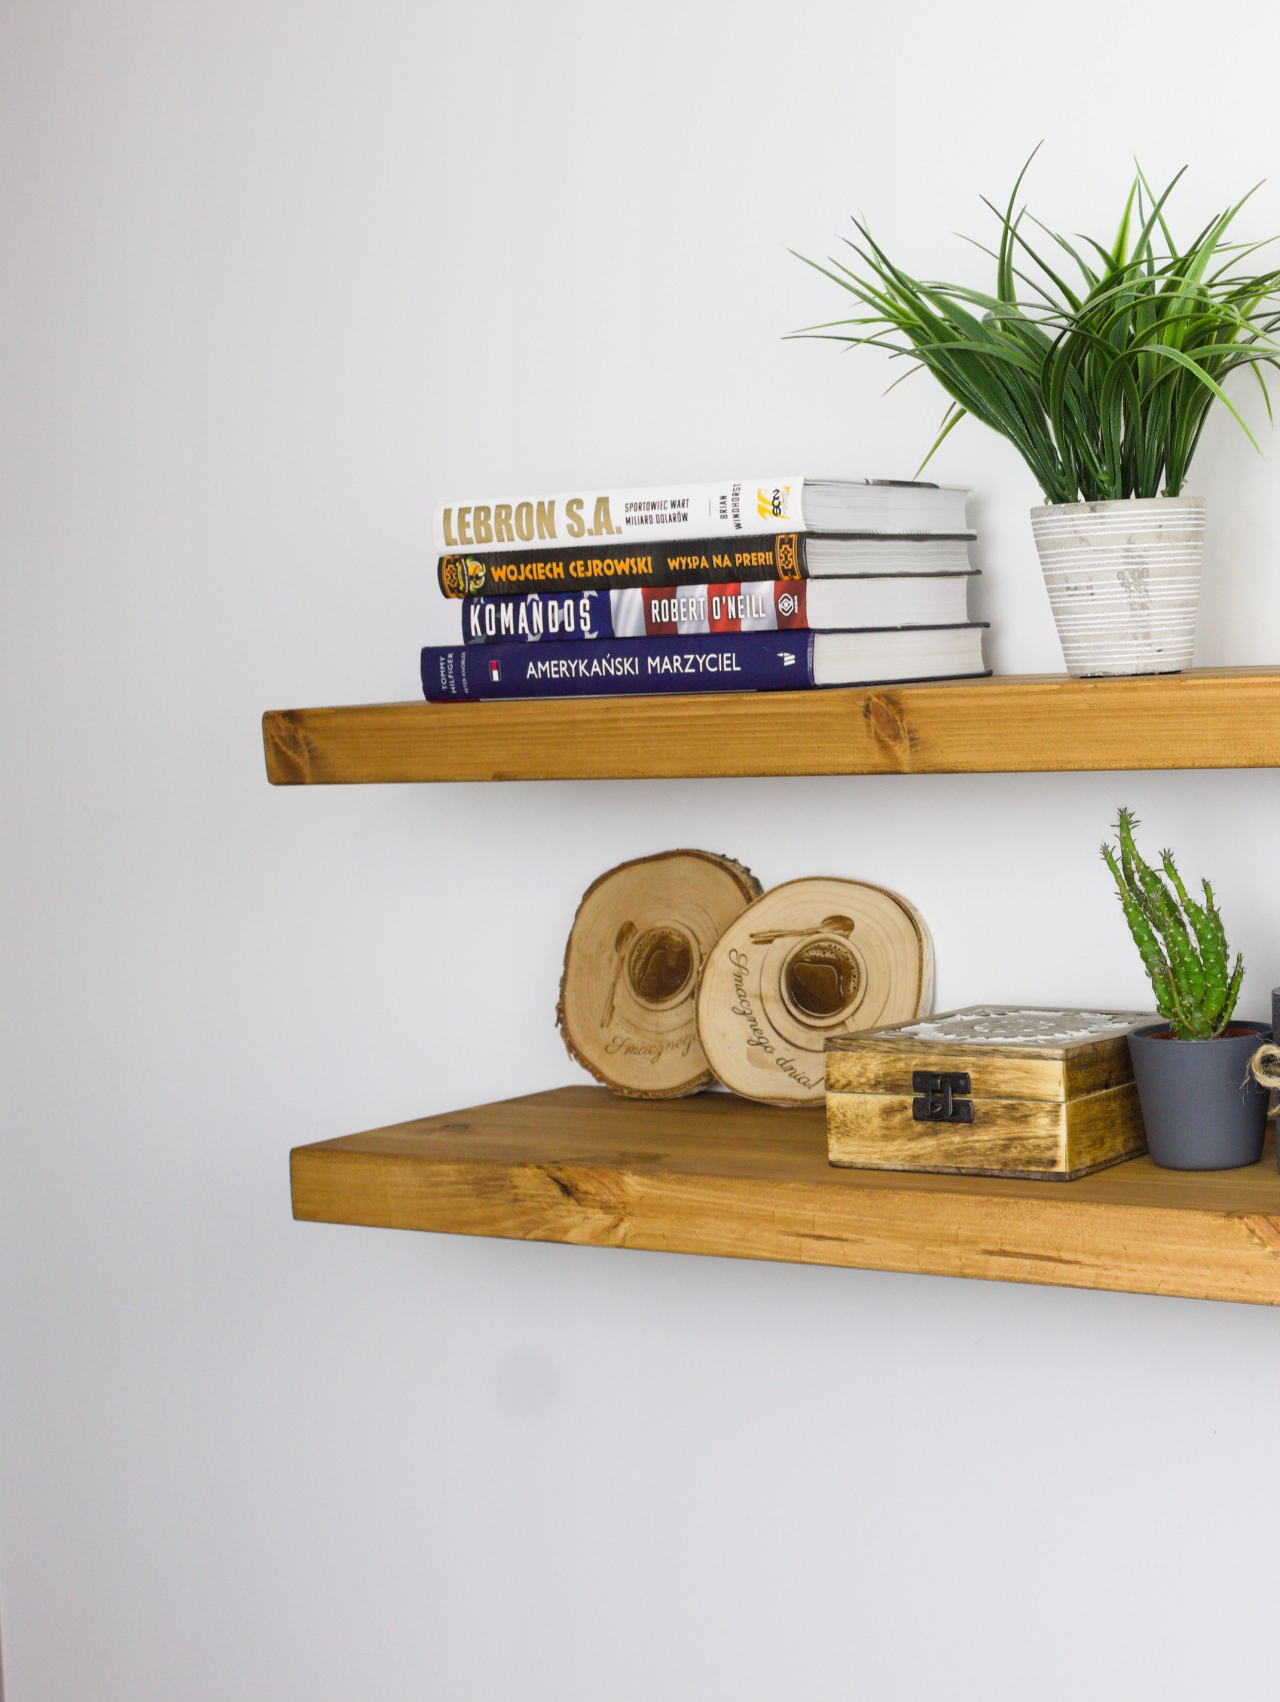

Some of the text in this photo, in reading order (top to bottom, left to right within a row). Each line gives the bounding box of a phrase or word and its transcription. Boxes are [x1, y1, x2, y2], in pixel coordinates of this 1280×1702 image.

[624, 498, 690, 513] SPORTOWIEC WART
[625, 510, 689, 526] MILIARD DOLARÓW
[719, 495, 728, 519] BRIAN
[731, 483, 742, 530] WINDHORST
[443, 496, 622, 547] LEBRON S.A.
[490, 562, 565, 583] WOJCIECH
[569, 556, 653, 578] CEJROWSKI
[667, 552, 773, 571] WYSPA NA PRERII
[470, 598, 591, 636] KOMANDOS
[651, 598, 707, 623] ROBERT
[712, 594, 766, 620] O'NEILL
[439, 656, 448, 691] TOMMY
[447, 652, 457, 694] HILFIGER
[526, 652, 741, 679] AMERYKAŃSKI MARZYCIEL
[728, 948, 825, 1090] Smacznego dnia!
